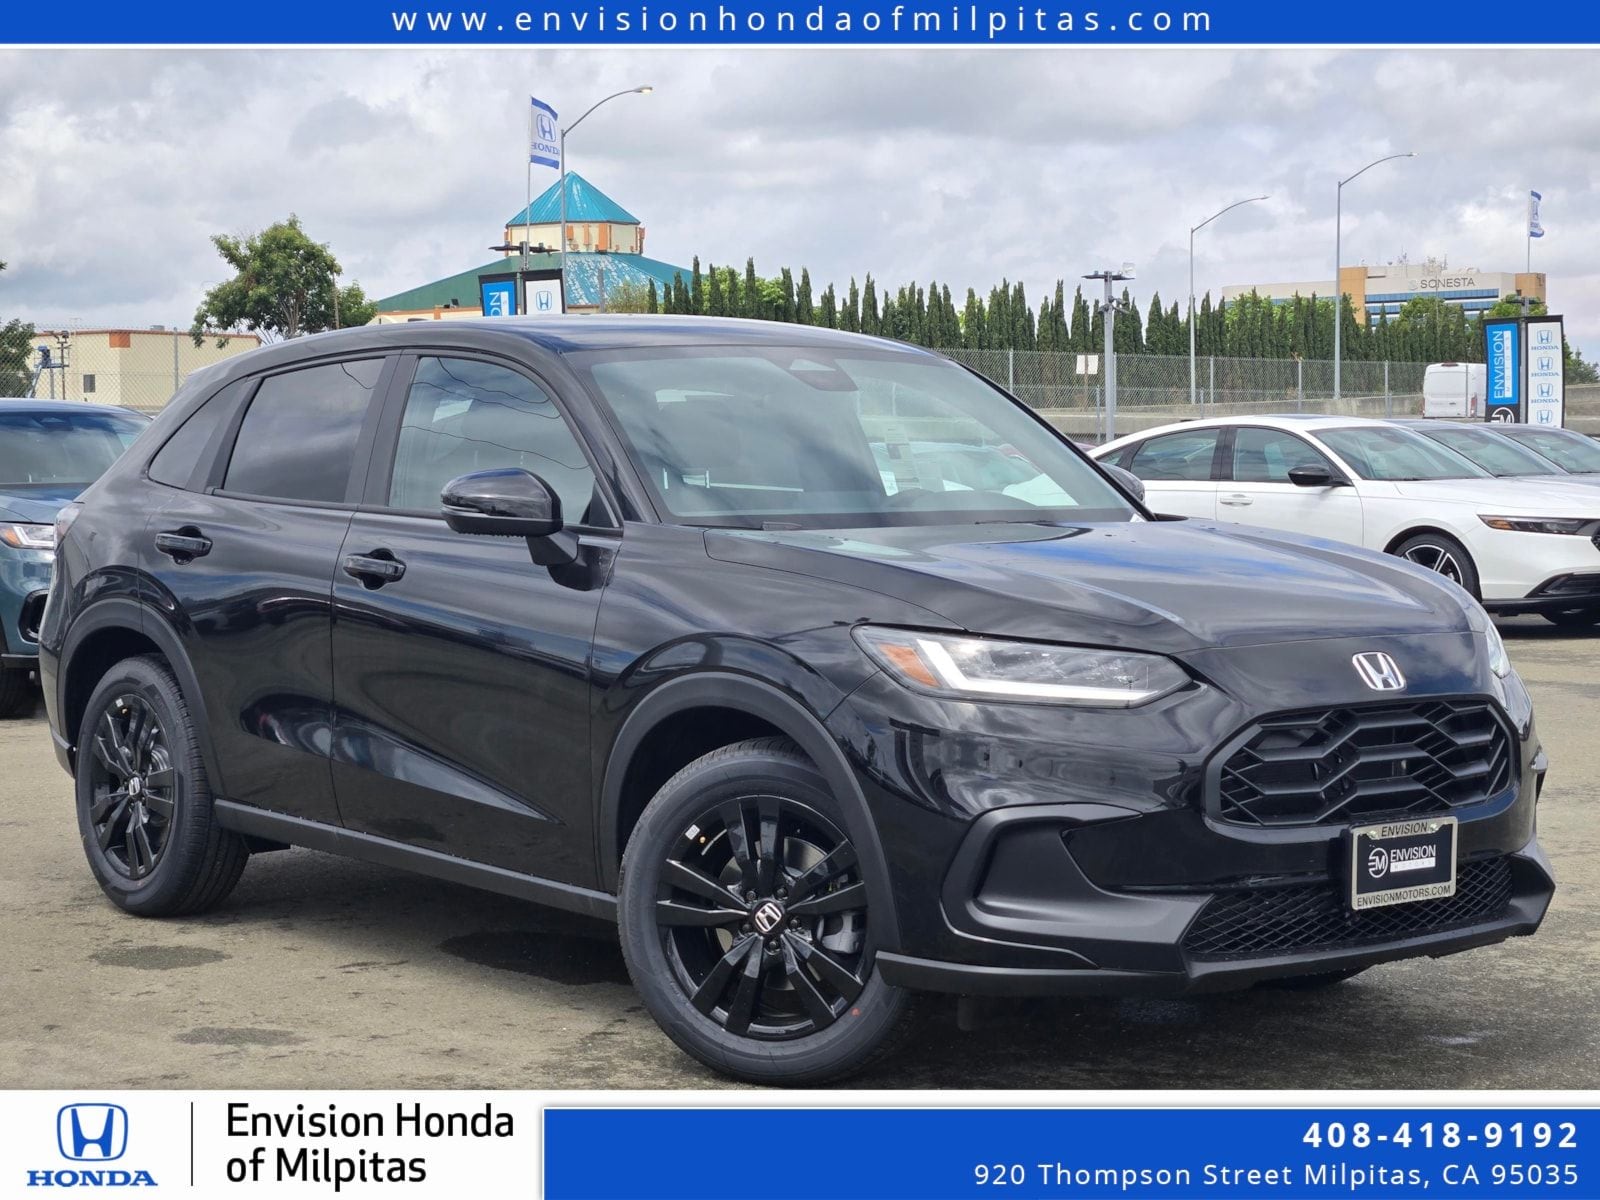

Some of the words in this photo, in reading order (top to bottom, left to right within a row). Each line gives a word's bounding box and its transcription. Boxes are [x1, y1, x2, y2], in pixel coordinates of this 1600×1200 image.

[1420, 277, 1476, 289] SONESTA
[1492, 331, 1504, 399] ENVISION
[1381, 822, 1428, 837] ENVISION
[1390, 844, 1436, 862] ENVISION
[1357, 885, 1451, 906] ENVISIONMOTORS.COM
